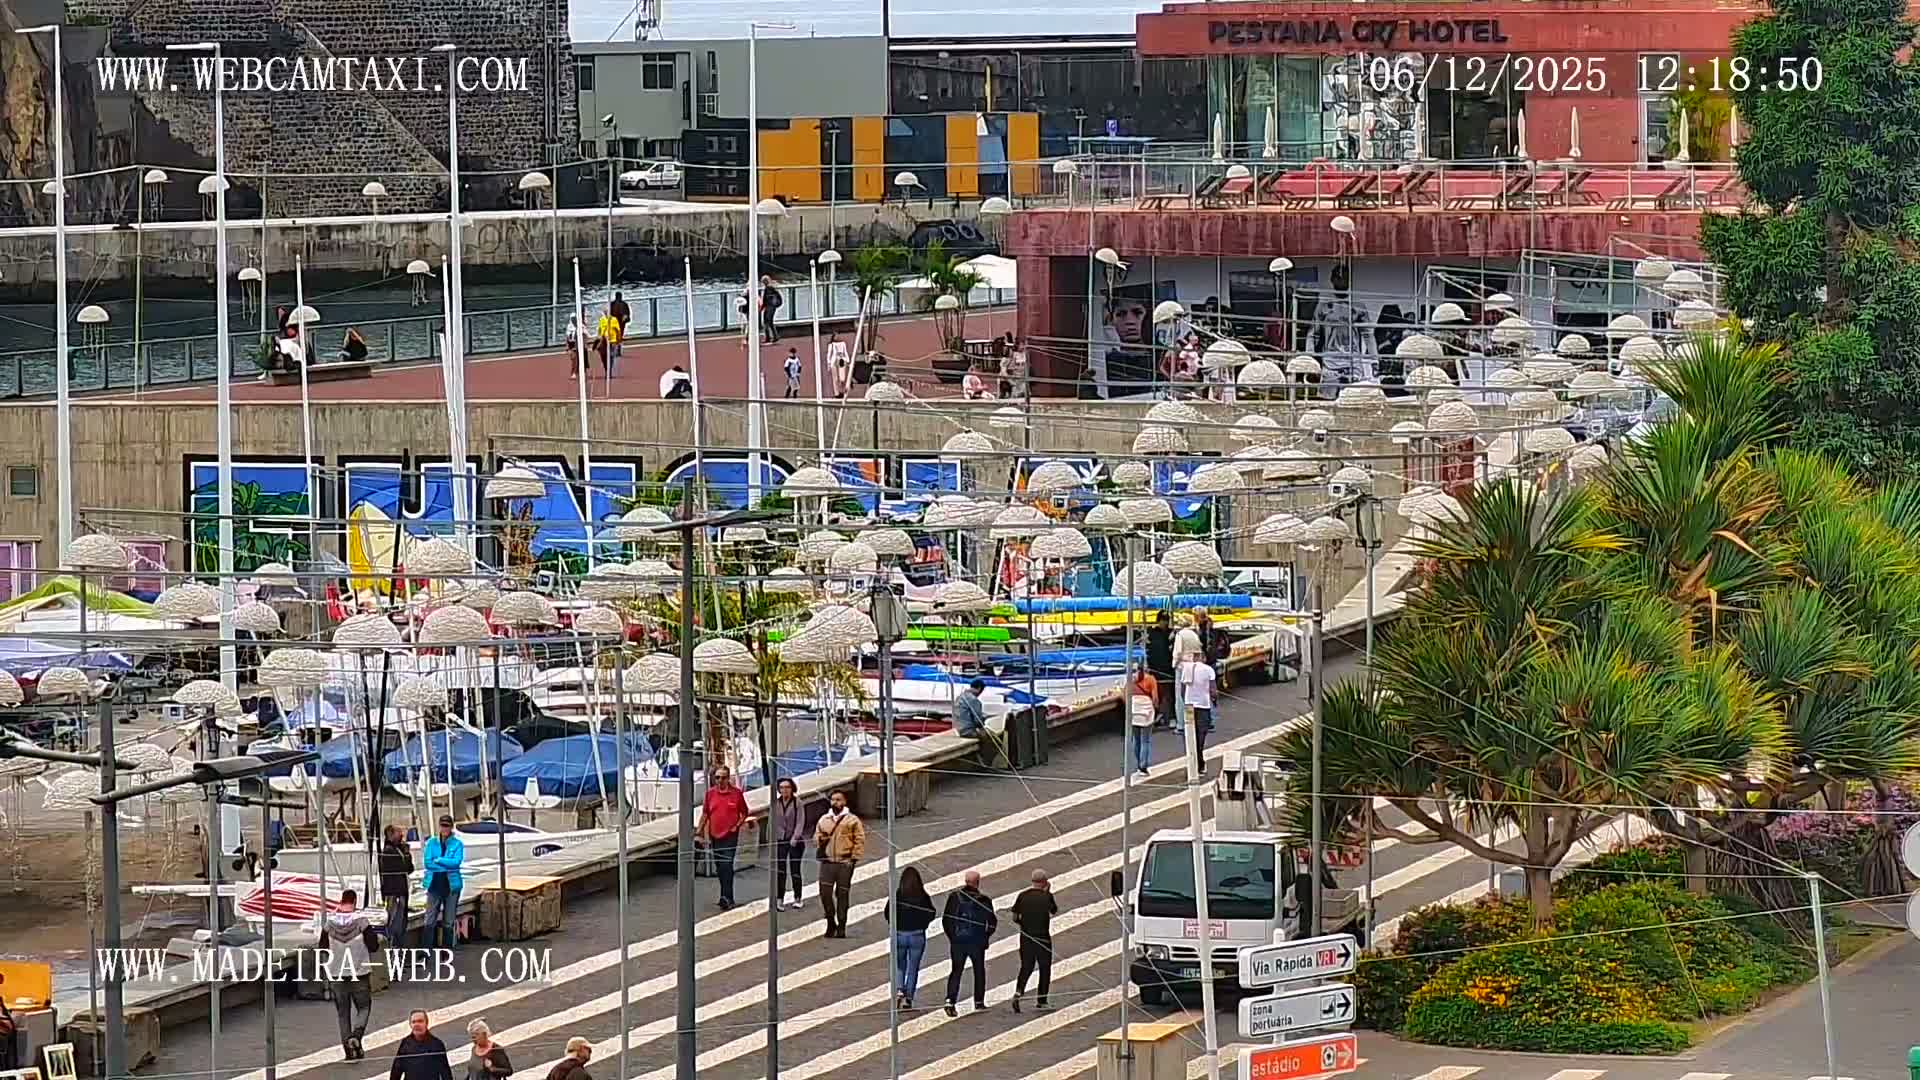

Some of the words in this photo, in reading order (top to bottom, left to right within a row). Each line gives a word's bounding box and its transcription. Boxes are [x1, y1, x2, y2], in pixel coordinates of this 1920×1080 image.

[1208, 20, 1342, 44] PESTANA
[1351, 20, 1398, 48] CR7
[1407, 19, 1508, 43] HOTEL
[1252, 960, 1270, 977] Via
[1275, 953, 1313, 973] Rápida
[1252, 1004, 1273, 1016] zona
[1252, 1014, 1293, 1032] portuária
[1252, 1055, 1301, 1077] estádio
